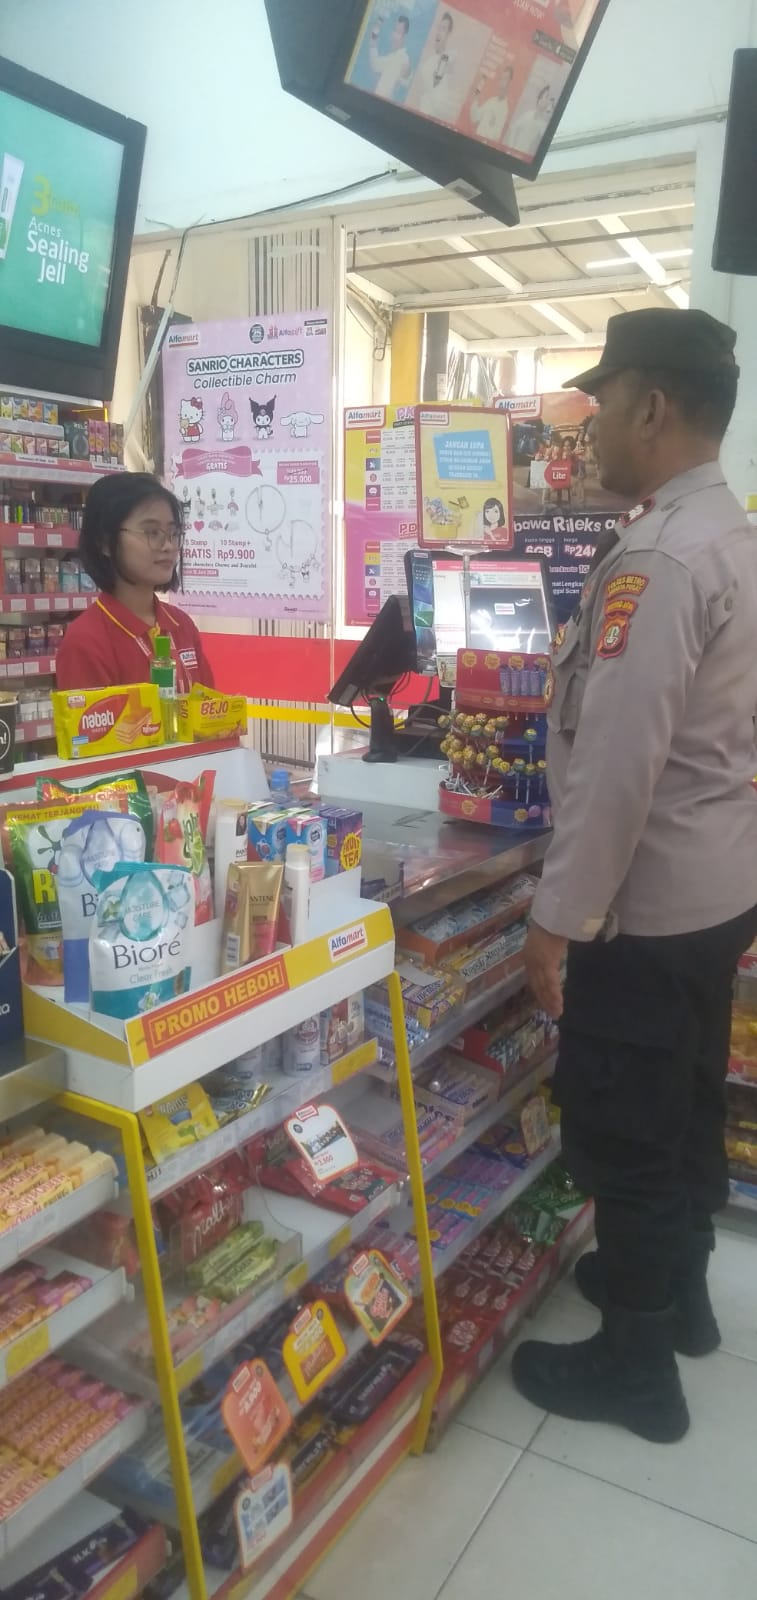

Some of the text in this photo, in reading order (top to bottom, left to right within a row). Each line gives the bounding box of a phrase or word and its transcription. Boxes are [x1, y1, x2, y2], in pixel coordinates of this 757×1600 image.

[31, 175, 52, 216] 3
[28, 215, 62, 238] Acnes
[26, 230, 90, 273] Sealing
[37, 258, 66, 285] Jell
[168, 333, 199, 344] Alfamart
[188, 352, 302, 373] SANRIO CHARACTERS
[193, 372, 297, 389] Collectible Charm
[498, 400, 537, 409] Alfamart
[348, 410, 382, 419] Alfamart
[552, 471, 567, 480] Lite
[553, 516, 602, 533] Rileks
[217, 549, 256, 561] Rp9.900
[200, 701, 229, 716] BEJO
[81, 710, 115, 731] nabati
[344, 851, 360, 867] TEA
[331, 926, 364, 951] Alfamart
[112, 932, 182, 970] Bioré
[154, 968, 281, 1041] PROMO HEBOH
